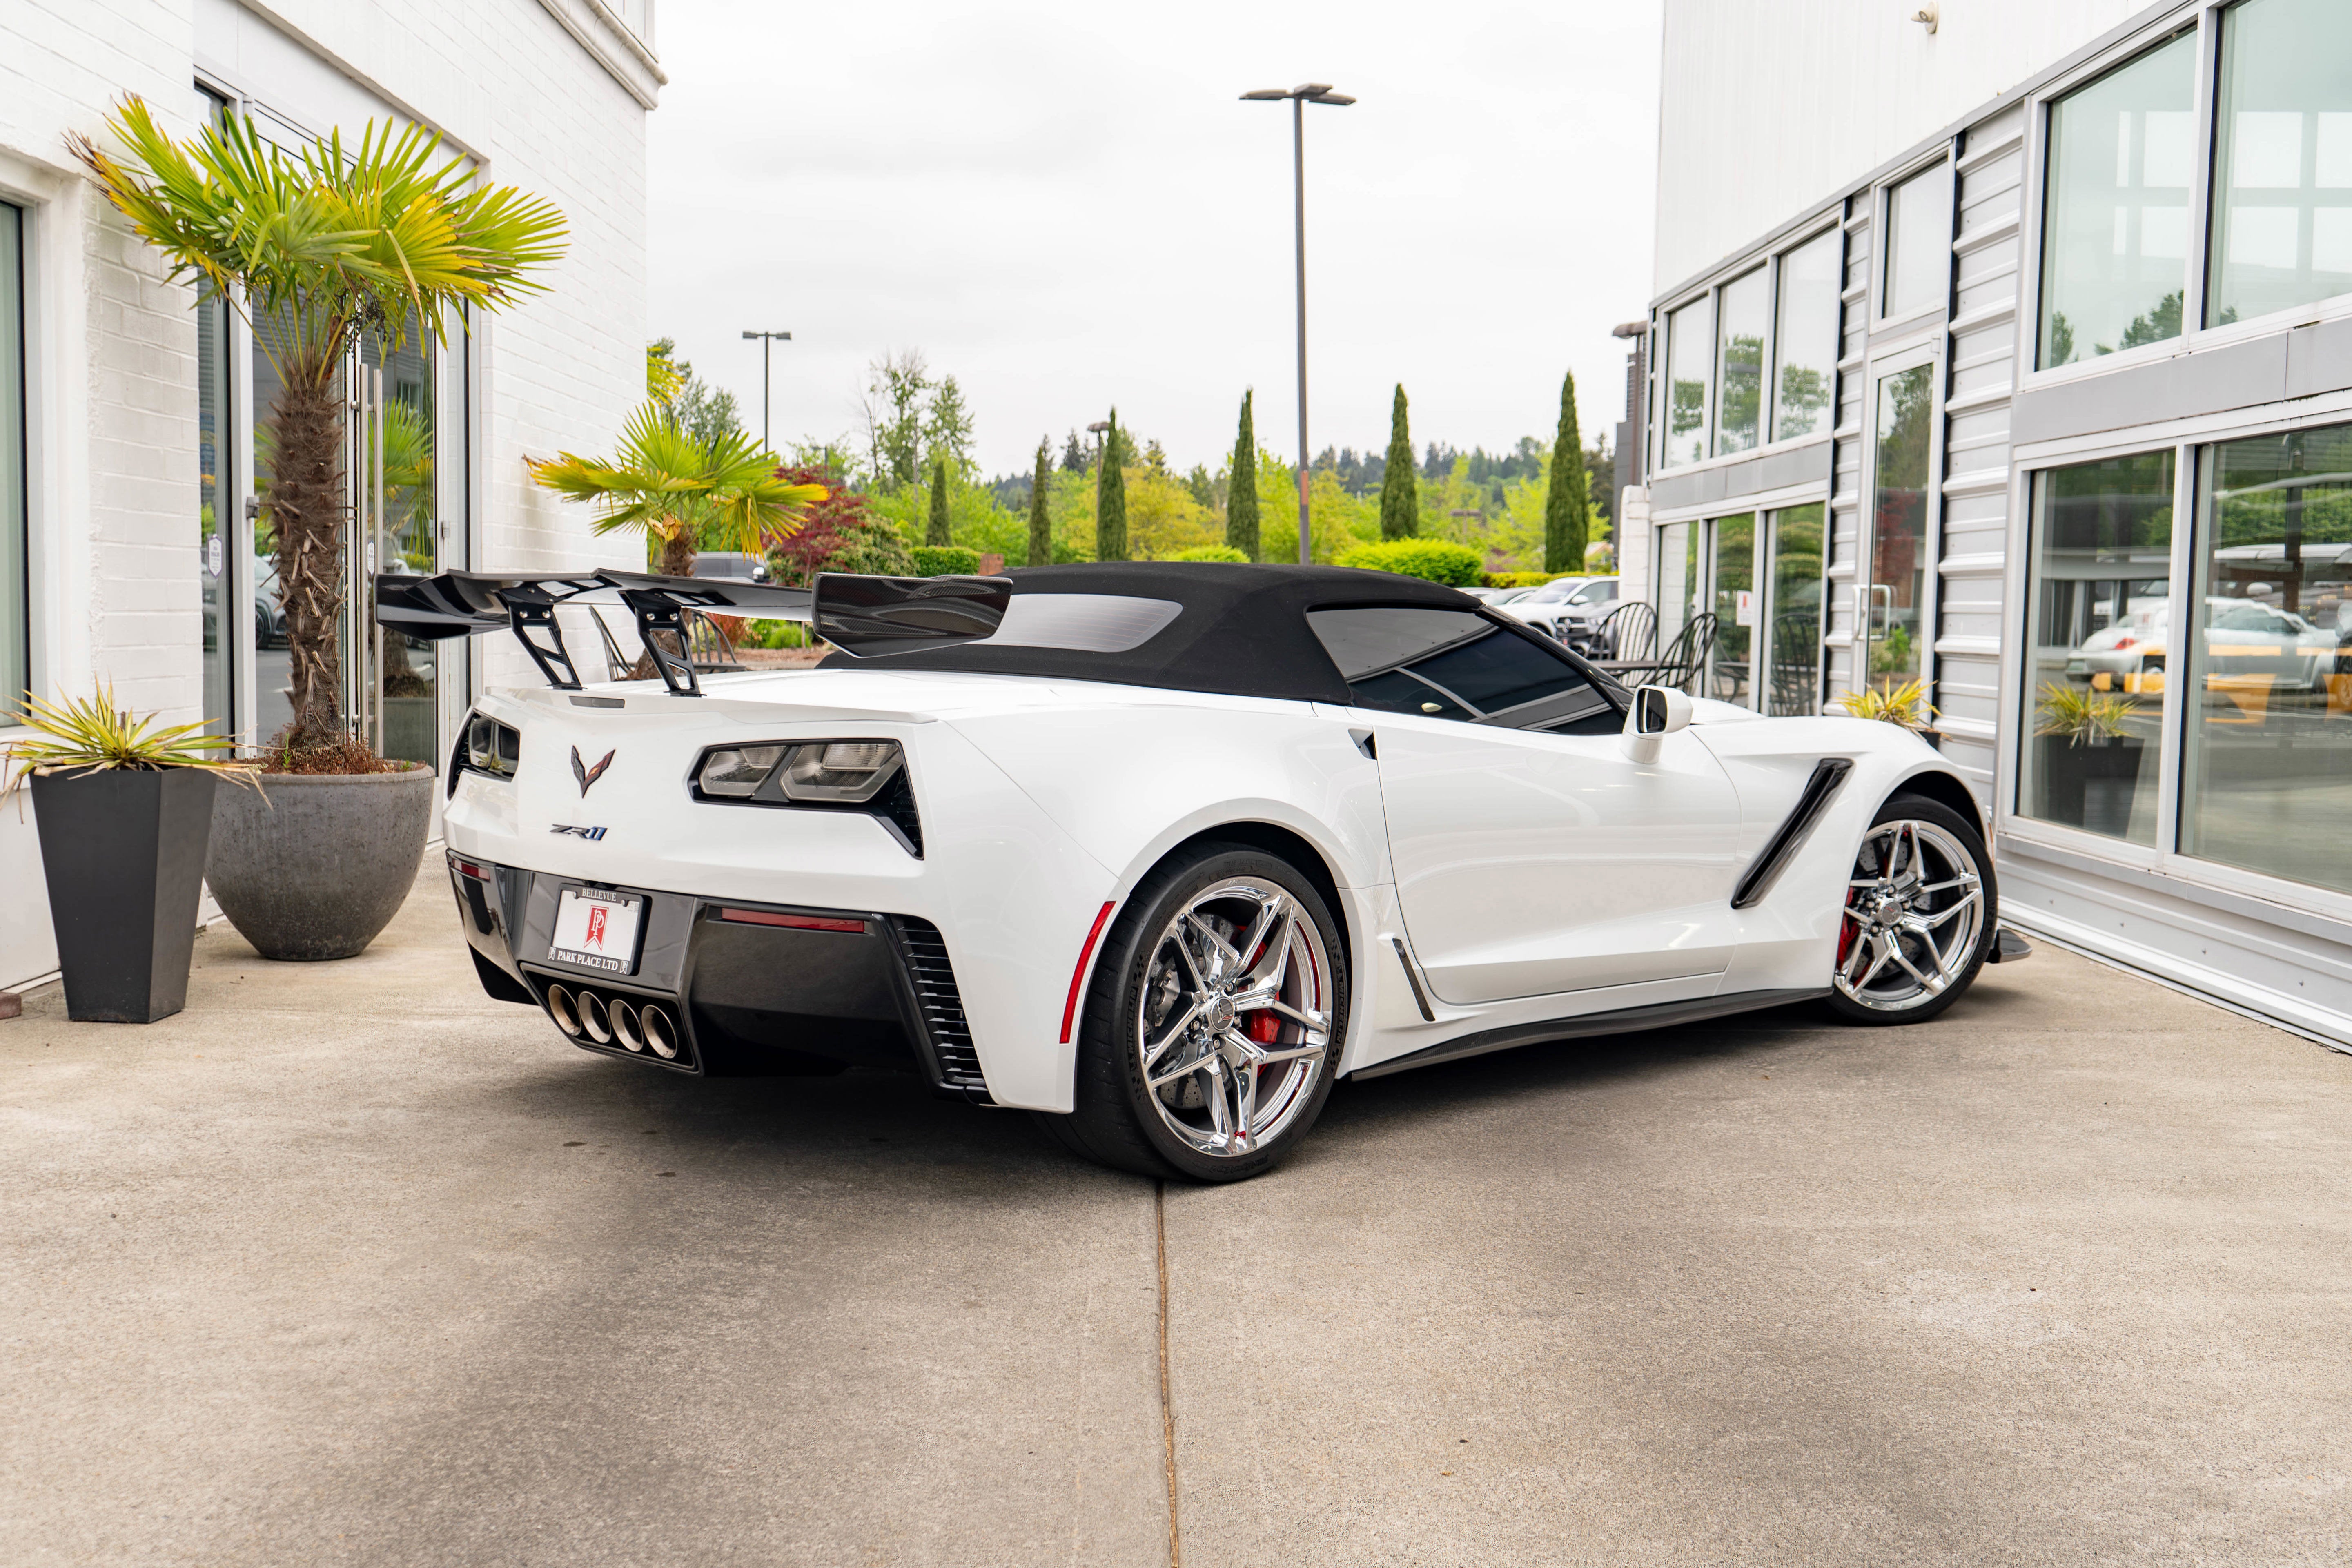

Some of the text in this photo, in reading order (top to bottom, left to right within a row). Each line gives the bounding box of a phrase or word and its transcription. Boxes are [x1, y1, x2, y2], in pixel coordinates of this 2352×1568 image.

[550, 824, 608, 841] ZR1
[582, 888, 617, 902] BELLEVUE
[557, 950, 618, 971] PARK PLACE LTD
[1127, 988, 1136, 1054] MICHELIN
